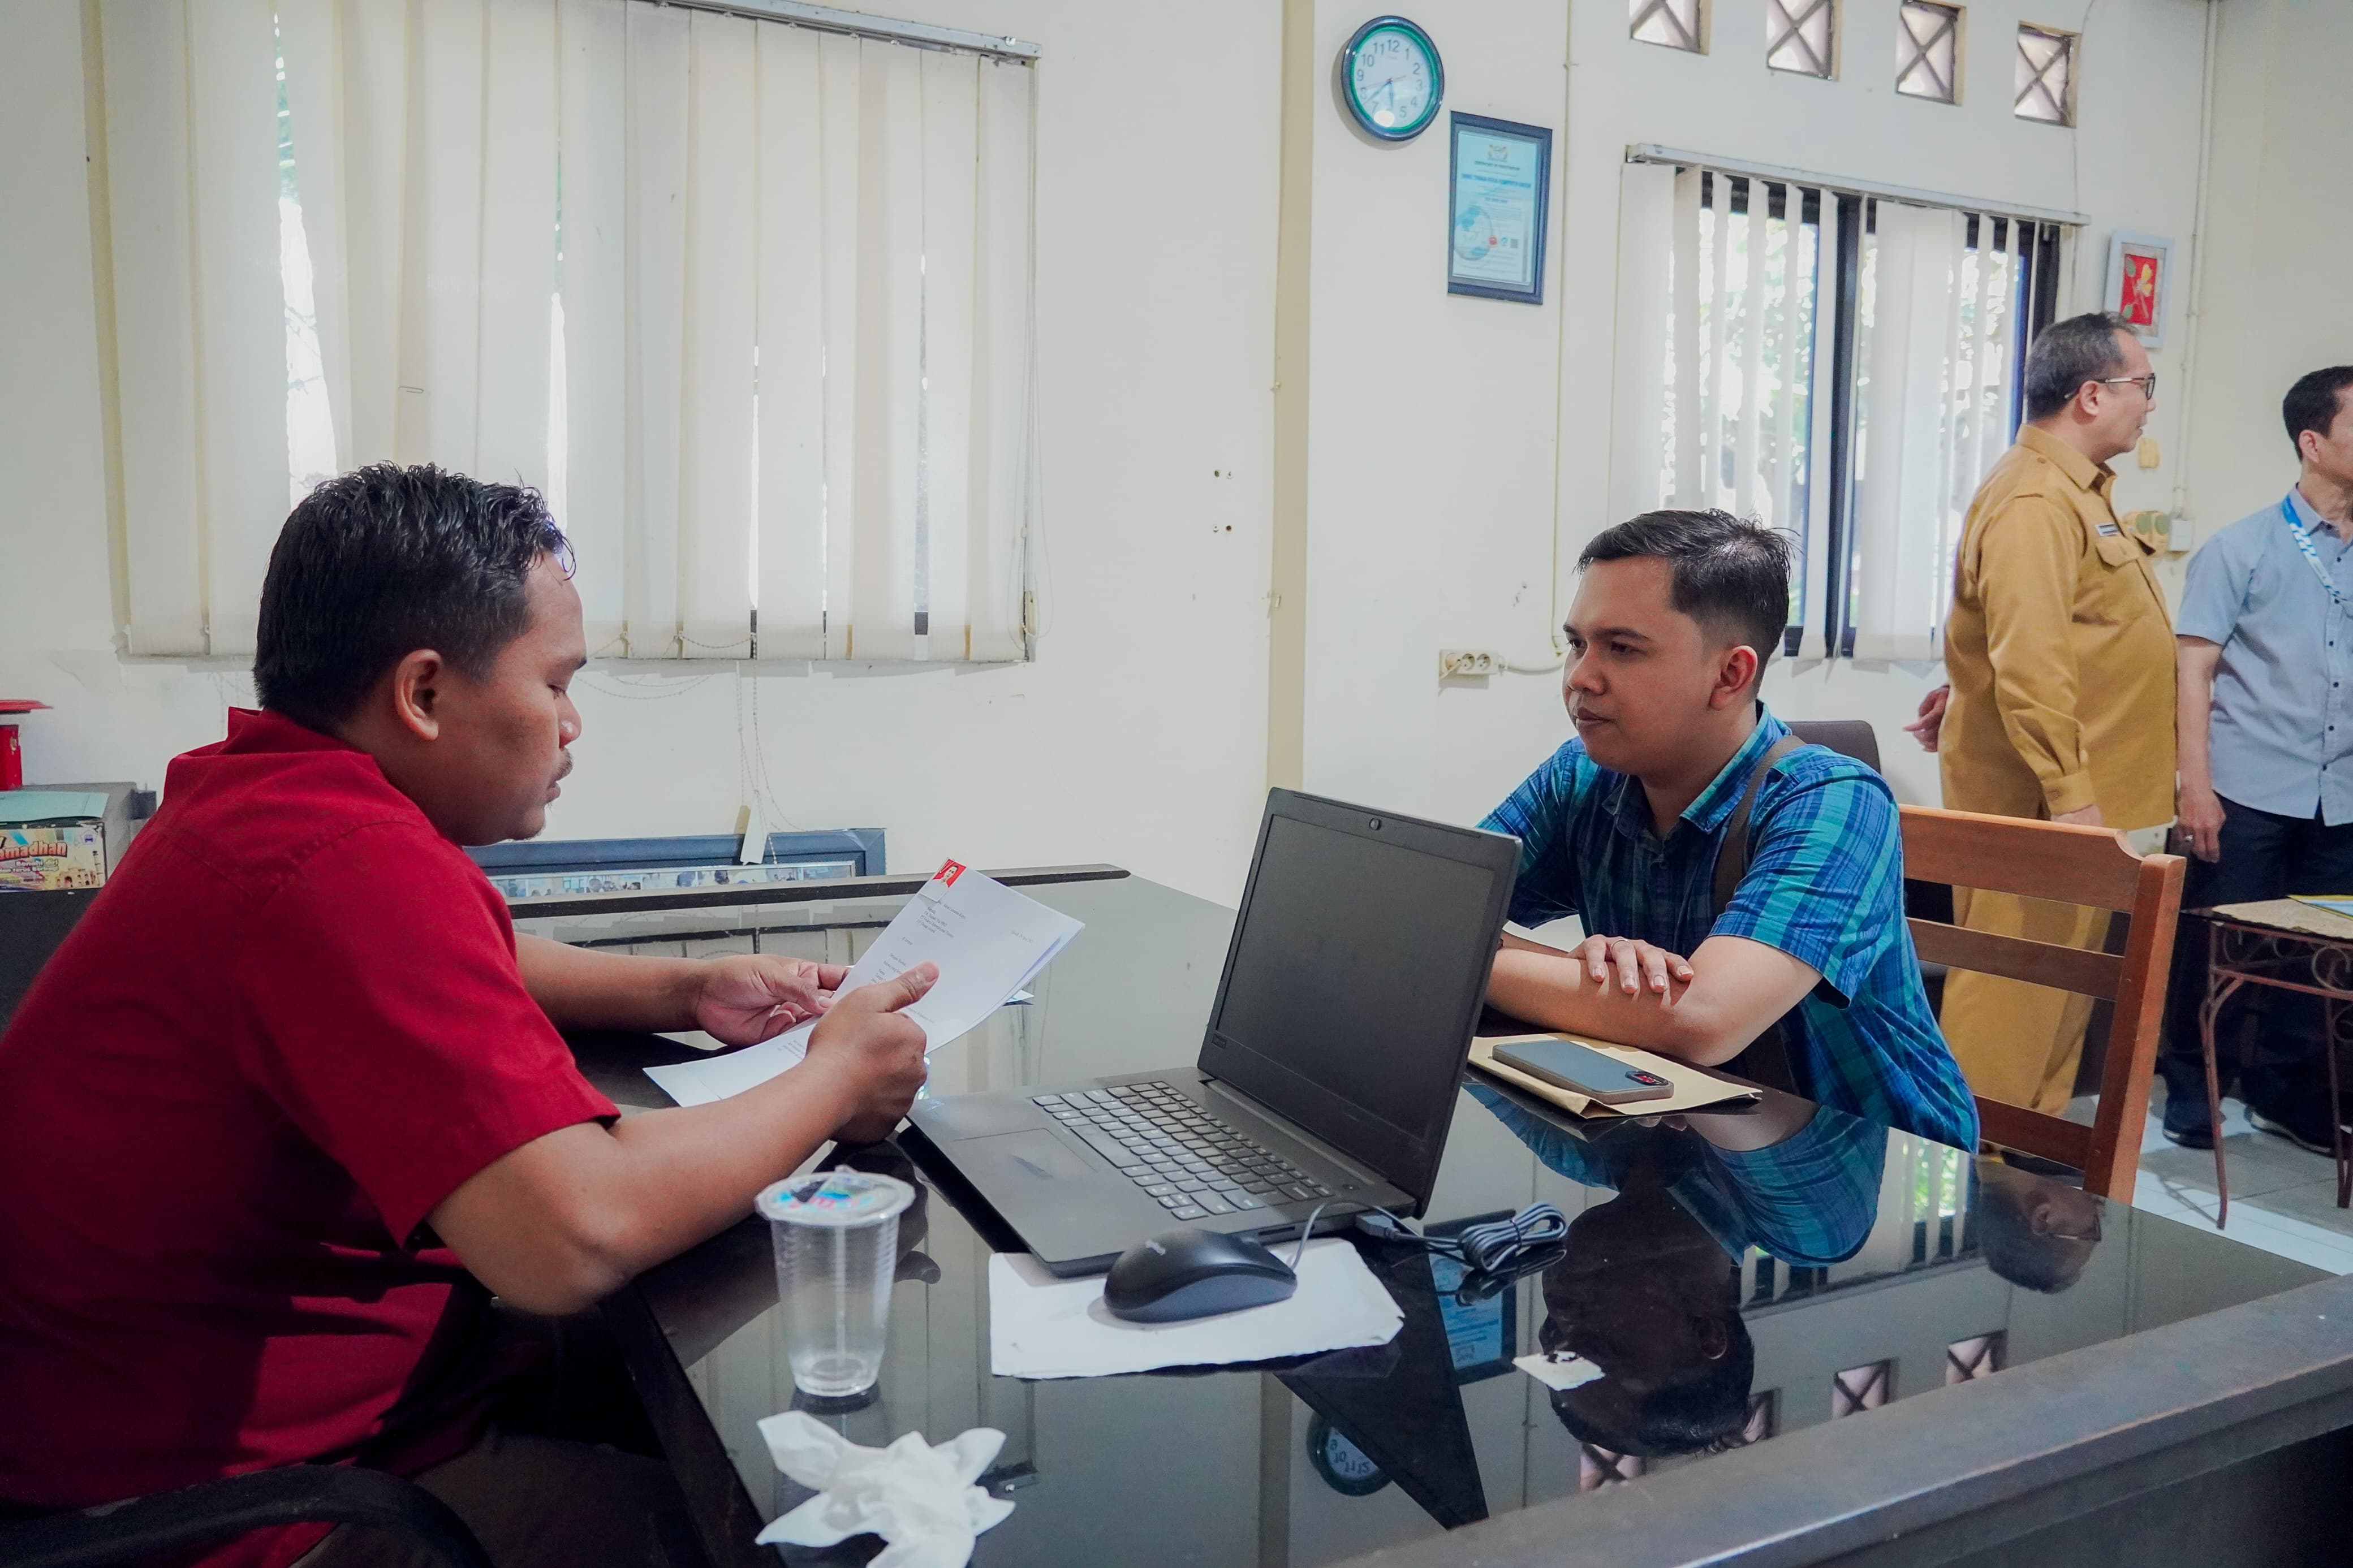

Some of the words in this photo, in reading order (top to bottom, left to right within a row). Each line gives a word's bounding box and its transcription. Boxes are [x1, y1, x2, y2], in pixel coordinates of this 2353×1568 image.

[1373, 42, 1384, 55] 11
[1387, 39, 1399, 53] 12
[1404, 48, 1410, 60] 1
[1361, 54, 1374, 67] 10
[1413, 63, 1420, 75] 2
[1357, 70, 1364, 81] 9
[1416, 80, 1423, 91] 3
[1360, 87, 1367, 100] 8
[1372, 101, 1379, 113] 7
[1411, 97, 1417, 107] 4
[1400, 106, 1407, 118] 5
